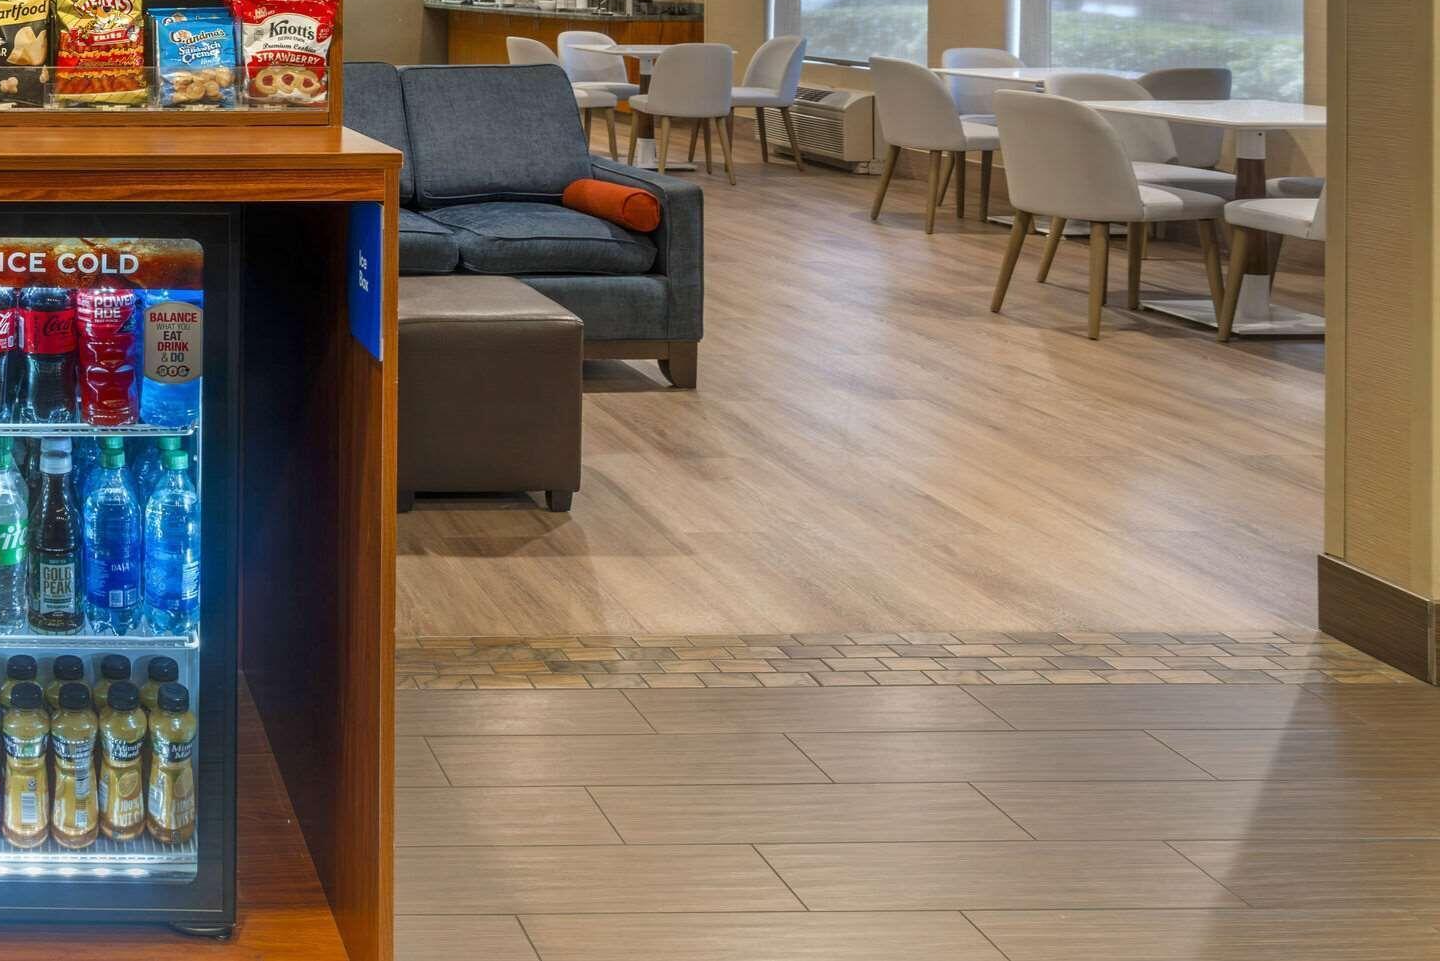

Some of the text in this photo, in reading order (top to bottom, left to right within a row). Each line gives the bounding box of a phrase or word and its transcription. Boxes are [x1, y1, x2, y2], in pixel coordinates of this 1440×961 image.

[269, 20, 315, 40] Knott's
[257, 52, 320, 64] STRAWBERRY
[58, 253, 139, 274] COLD
[94, 294, 136, 308] POWER
[94, 307, 120, 319] ADE
[150, 312, 198, 323] BALANCE
[163, 331, 182, 341] EAT
[157, 341, 189, 352] DRINK
[171, 352, 184, 362] DO
[111, 562, 133, 572] DASA
[44, 567, 72, 580] GOLD
[44, 581, 72, 594] PEAK
